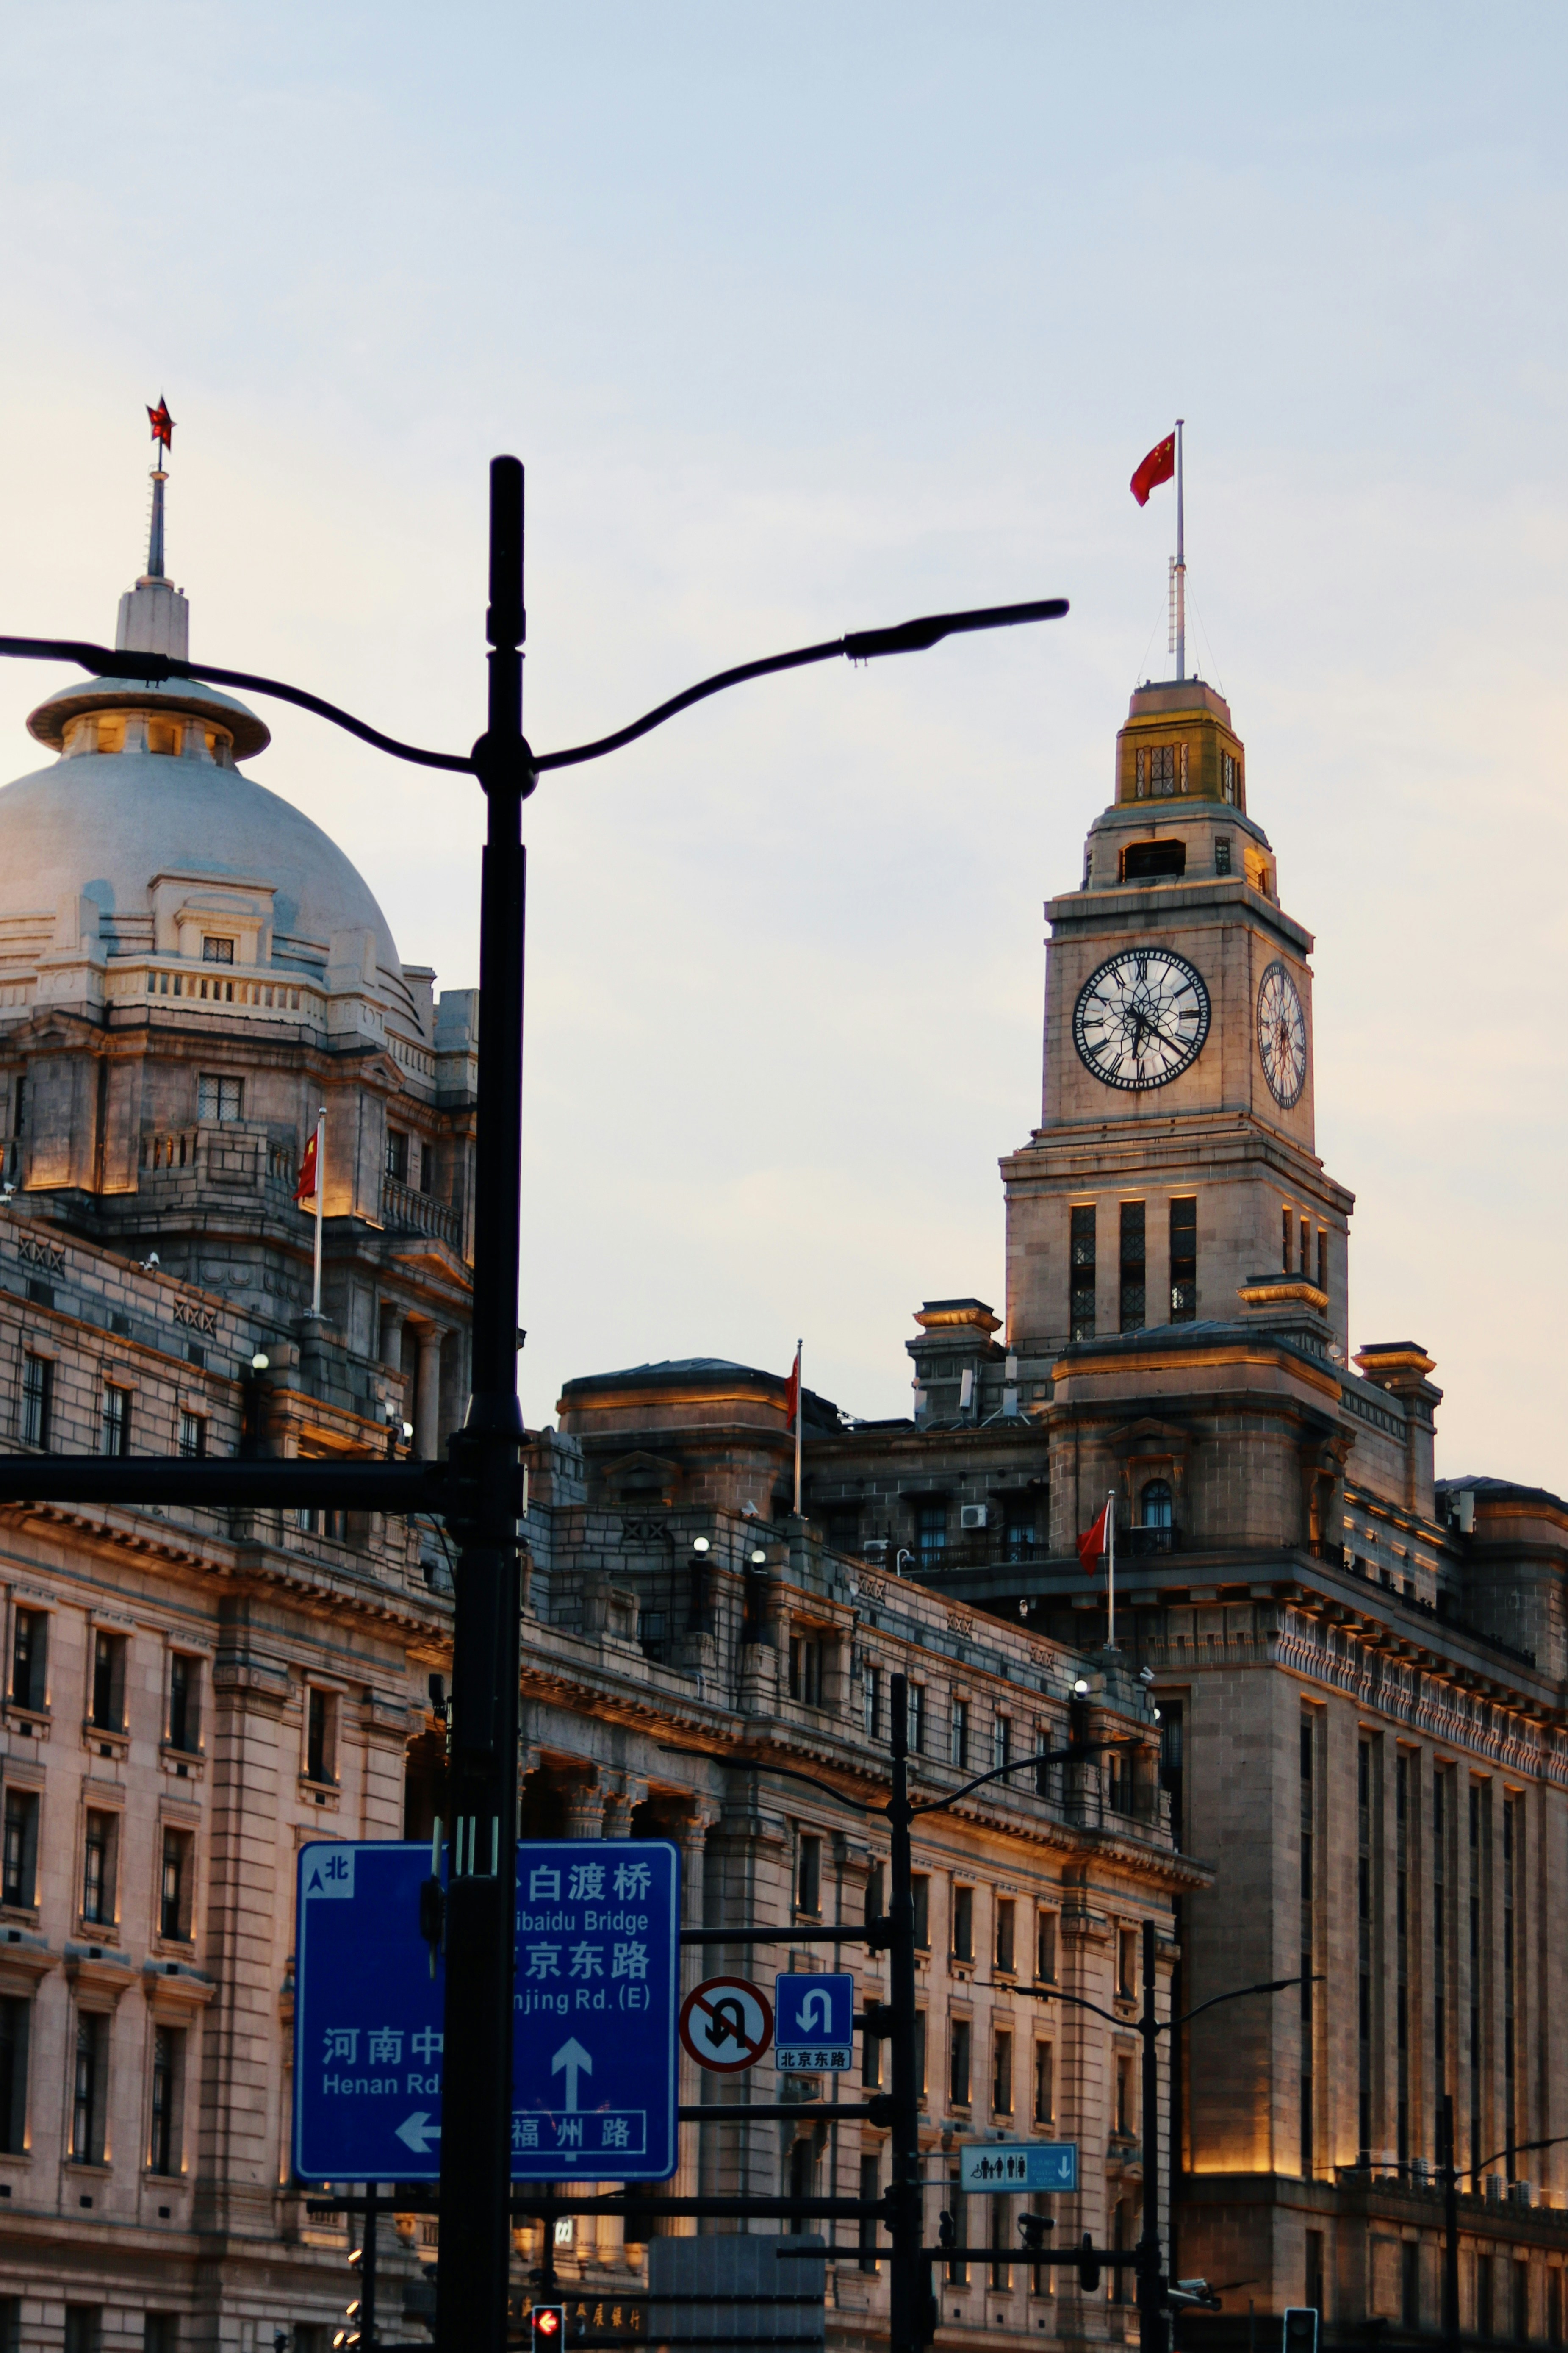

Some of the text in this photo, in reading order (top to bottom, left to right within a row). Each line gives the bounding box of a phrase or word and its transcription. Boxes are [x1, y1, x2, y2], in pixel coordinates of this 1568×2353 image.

[325, 1856, 349, 1880] 北
[516, 1862, 652, 1902] 白渡桥
[516, 1910, 648, 1936] ibaidu Bridge
[514, 1941, 650, 1980] 京东路
[513, 1984, 650, 2014] njing Rd. (E)
[322, 2026, 444, 2065] 河南中
[781, 2051, 845, 2067] 北京东路
[323, 2074, 398, 2094] Henan
[511, 2117, 631, 2148] 福州路
